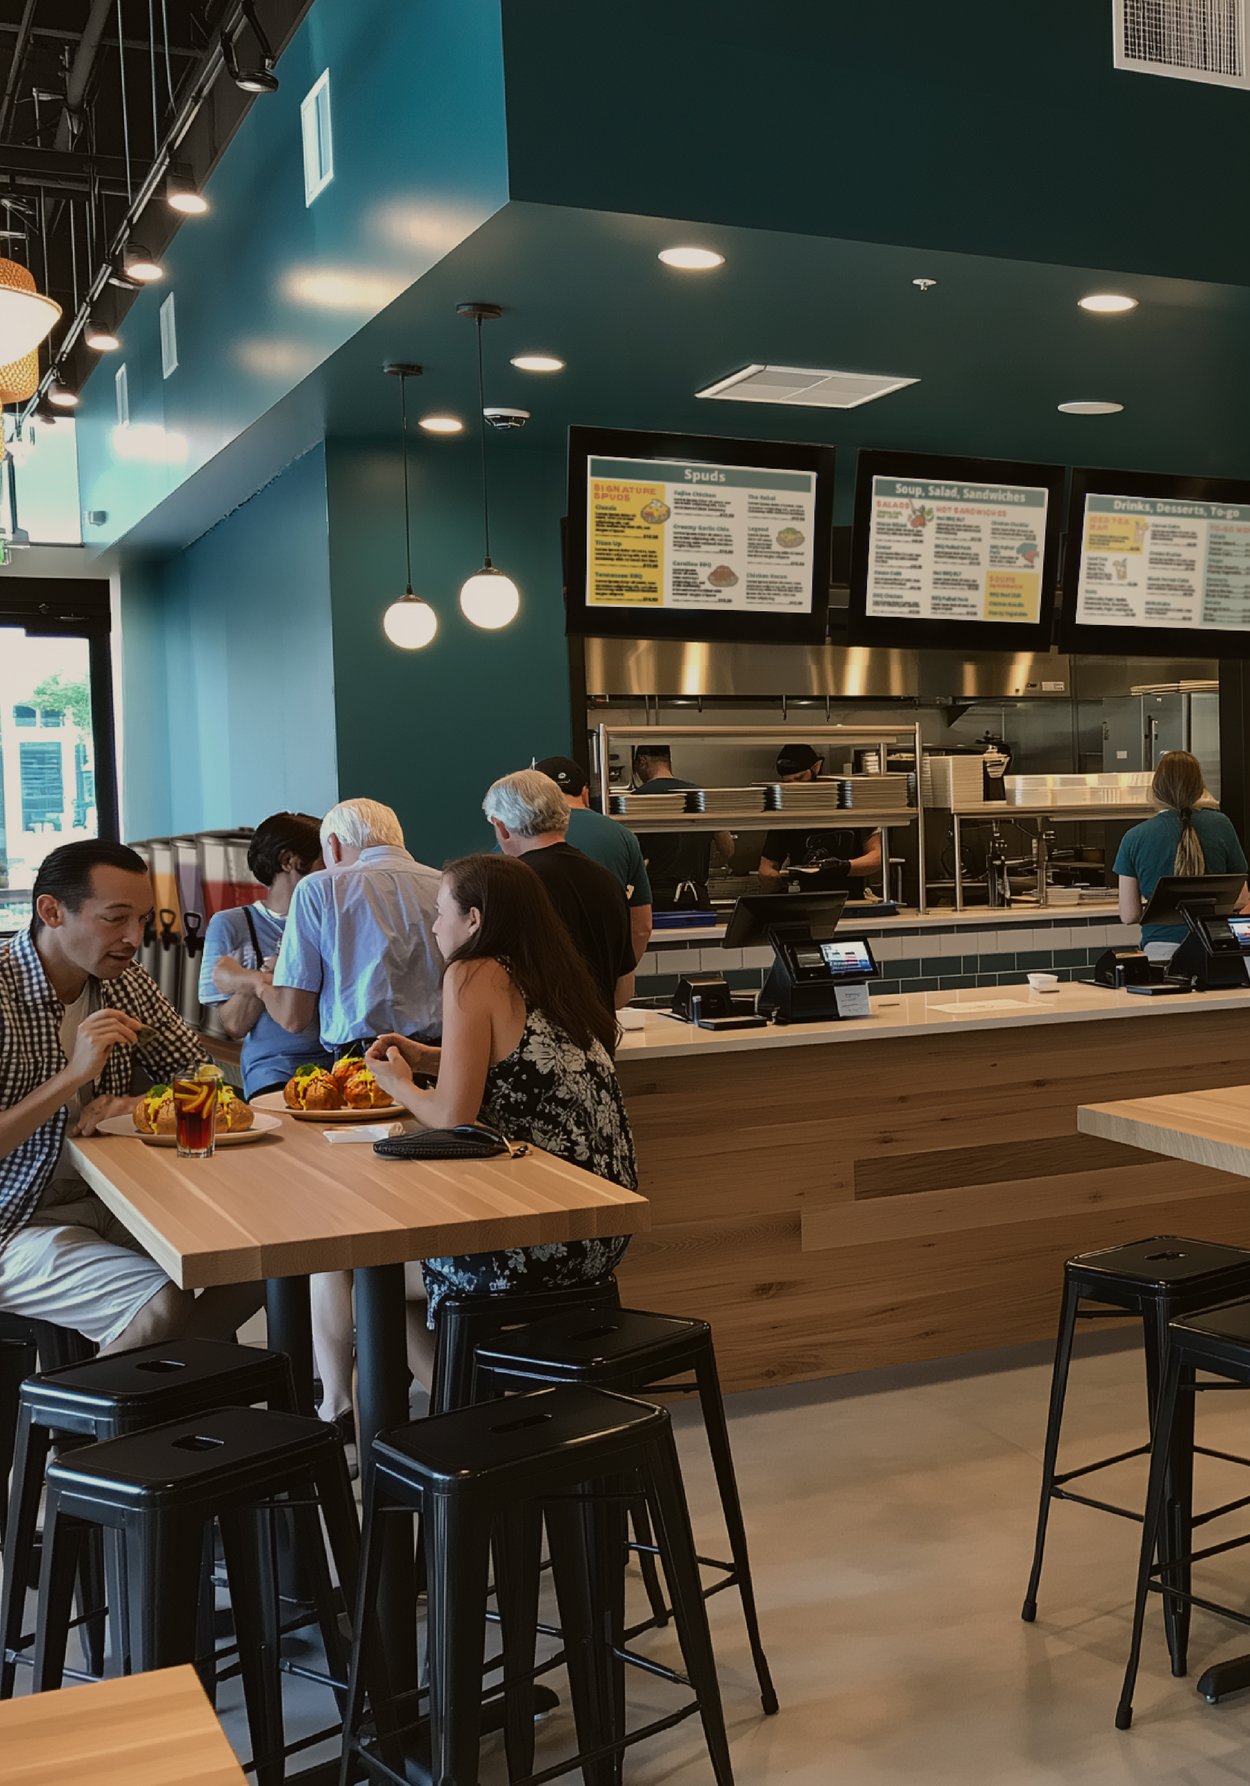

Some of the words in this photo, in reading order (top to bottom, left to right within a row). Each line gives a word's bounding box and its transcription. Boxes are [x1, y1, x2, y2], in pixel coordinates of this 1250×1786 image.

[684, 468, 726, 483] Spuds
[594, 484, 656, 495] SIGNATURE
[594, 492, 630, 502] SPUDS
[895, 483, 925, 497] Soup,
[928, 485, 960, 499] Salad,
[963, 487, 1026, 503] Sandwiches
[1114, 500, 1154, 514] Drinks,
[1157, 502, 1207, 518] Desserts,
[1210, 505, 1240, 520] To-go
